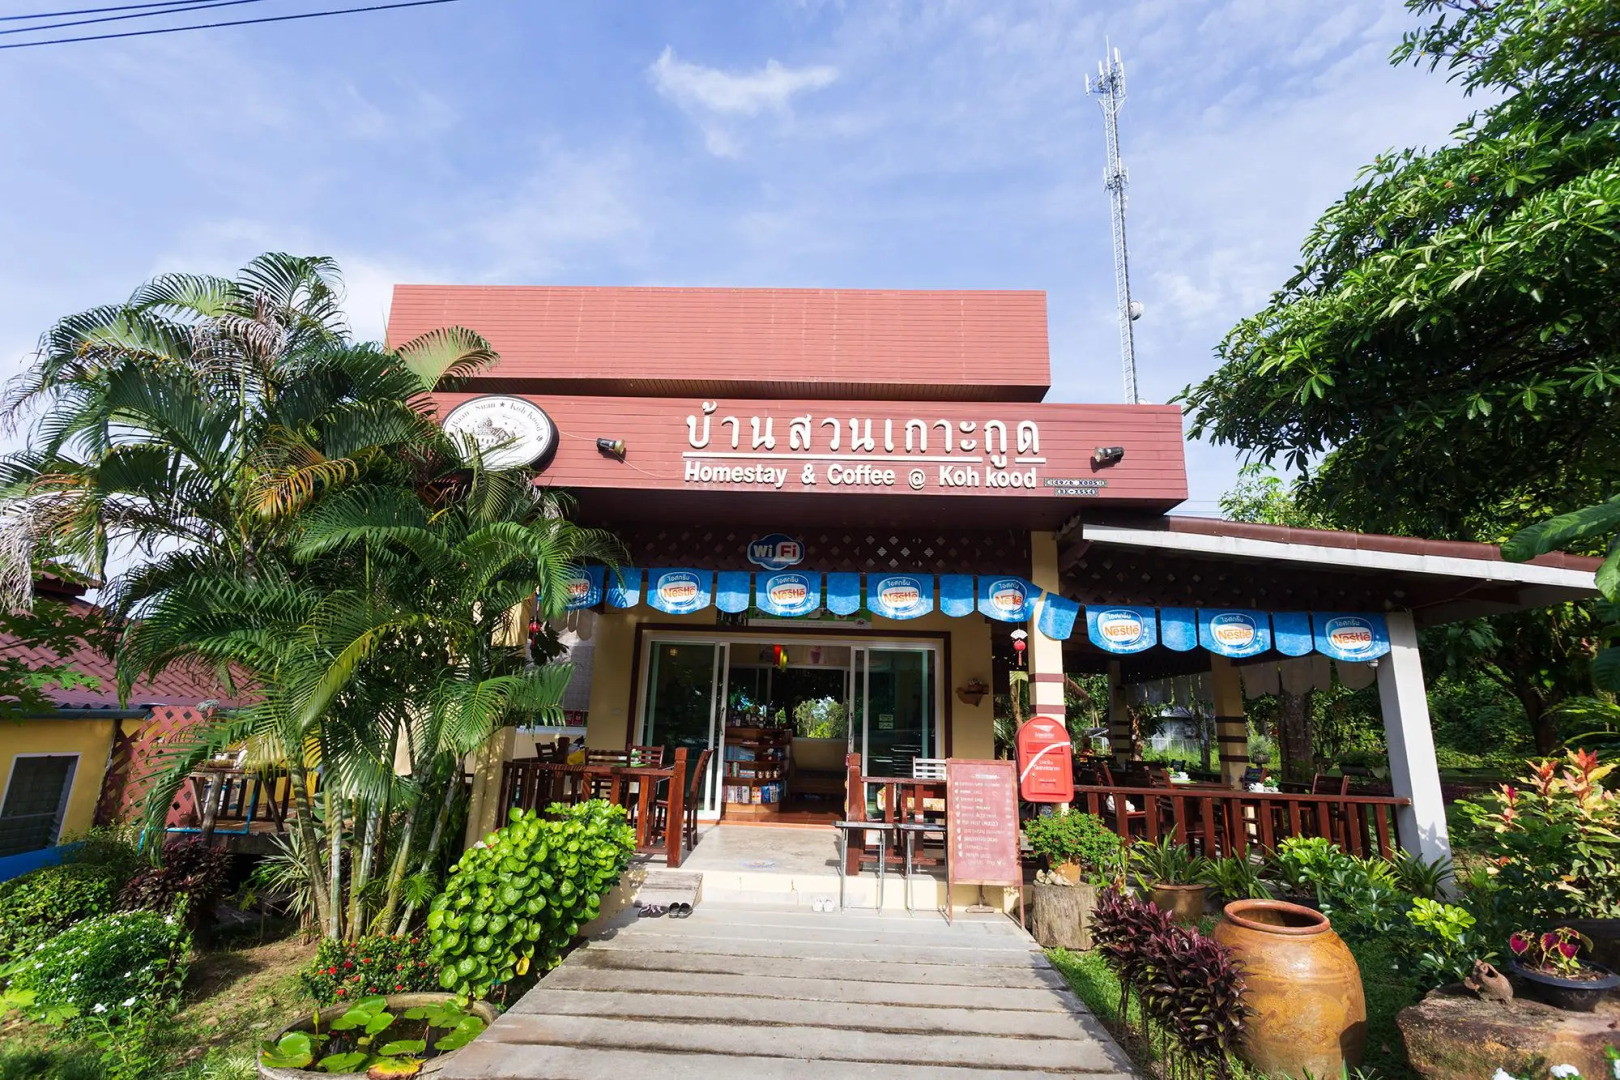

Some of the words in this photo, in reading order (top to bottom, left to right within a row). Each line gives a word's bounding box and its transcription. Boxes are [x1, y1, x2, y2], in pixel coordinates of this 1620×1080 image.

[510, 402, 526, 414] Koh
[684, 460, 788, 489] Homestay
[800, 463, 818, 486] &
[827, 463, 896, 487] Coffee
[908, 467, 926, 490] @
[939, 464, 980, 488] Koh
[984, 465, 1037, 489] kood
